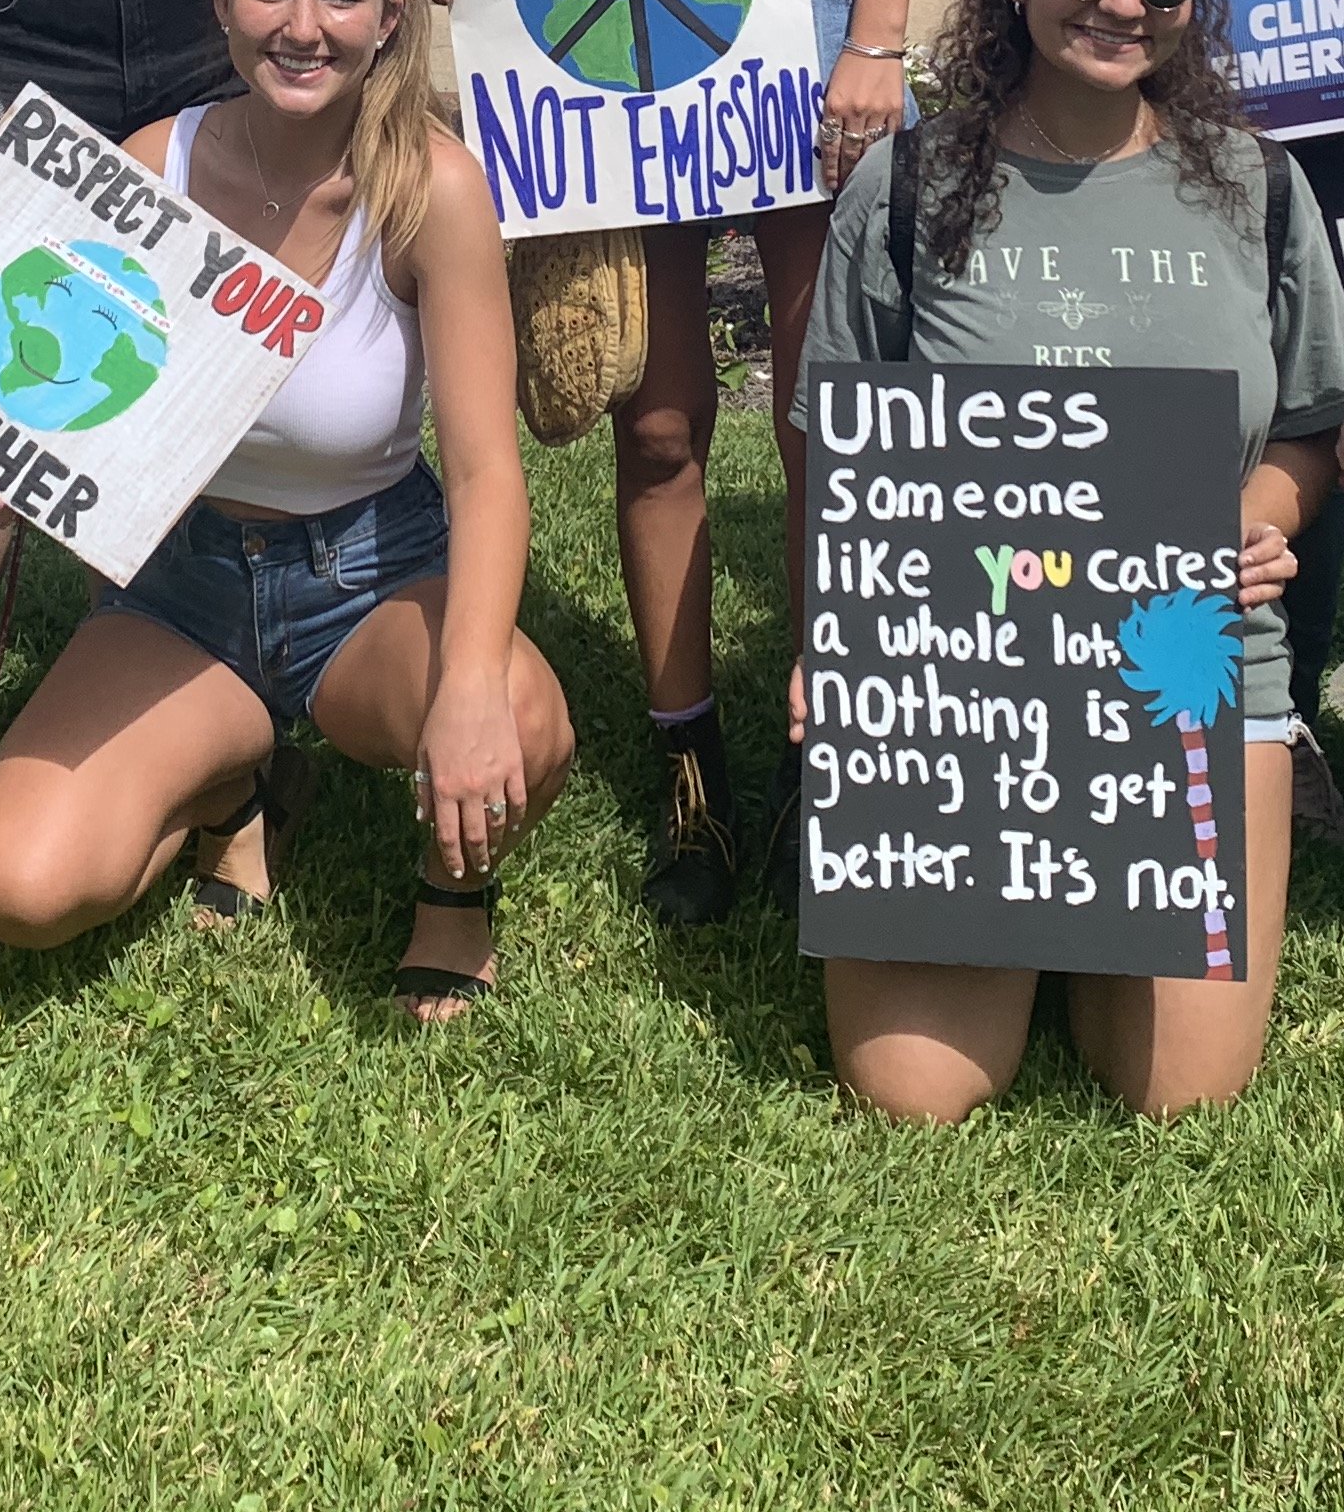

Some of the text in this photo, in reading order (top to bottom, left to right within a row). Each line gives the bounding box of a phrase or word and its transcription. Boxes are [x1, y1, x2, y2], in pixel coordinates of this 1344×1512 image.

[471, 69, 605, 223] NOT
[189, 231, 325, 358] YOUR
[1111, 247, 1209, 287] THE
[1088, 542, 1237, 592] cares
[813, 613, 848, 656] a
[878, 605, 1025, 667] whole
[812, 665, 1130, 770] nothing is
[809, 743, 1176, 825] going to get
[807, 816, 1235, 912] better. It's not.
